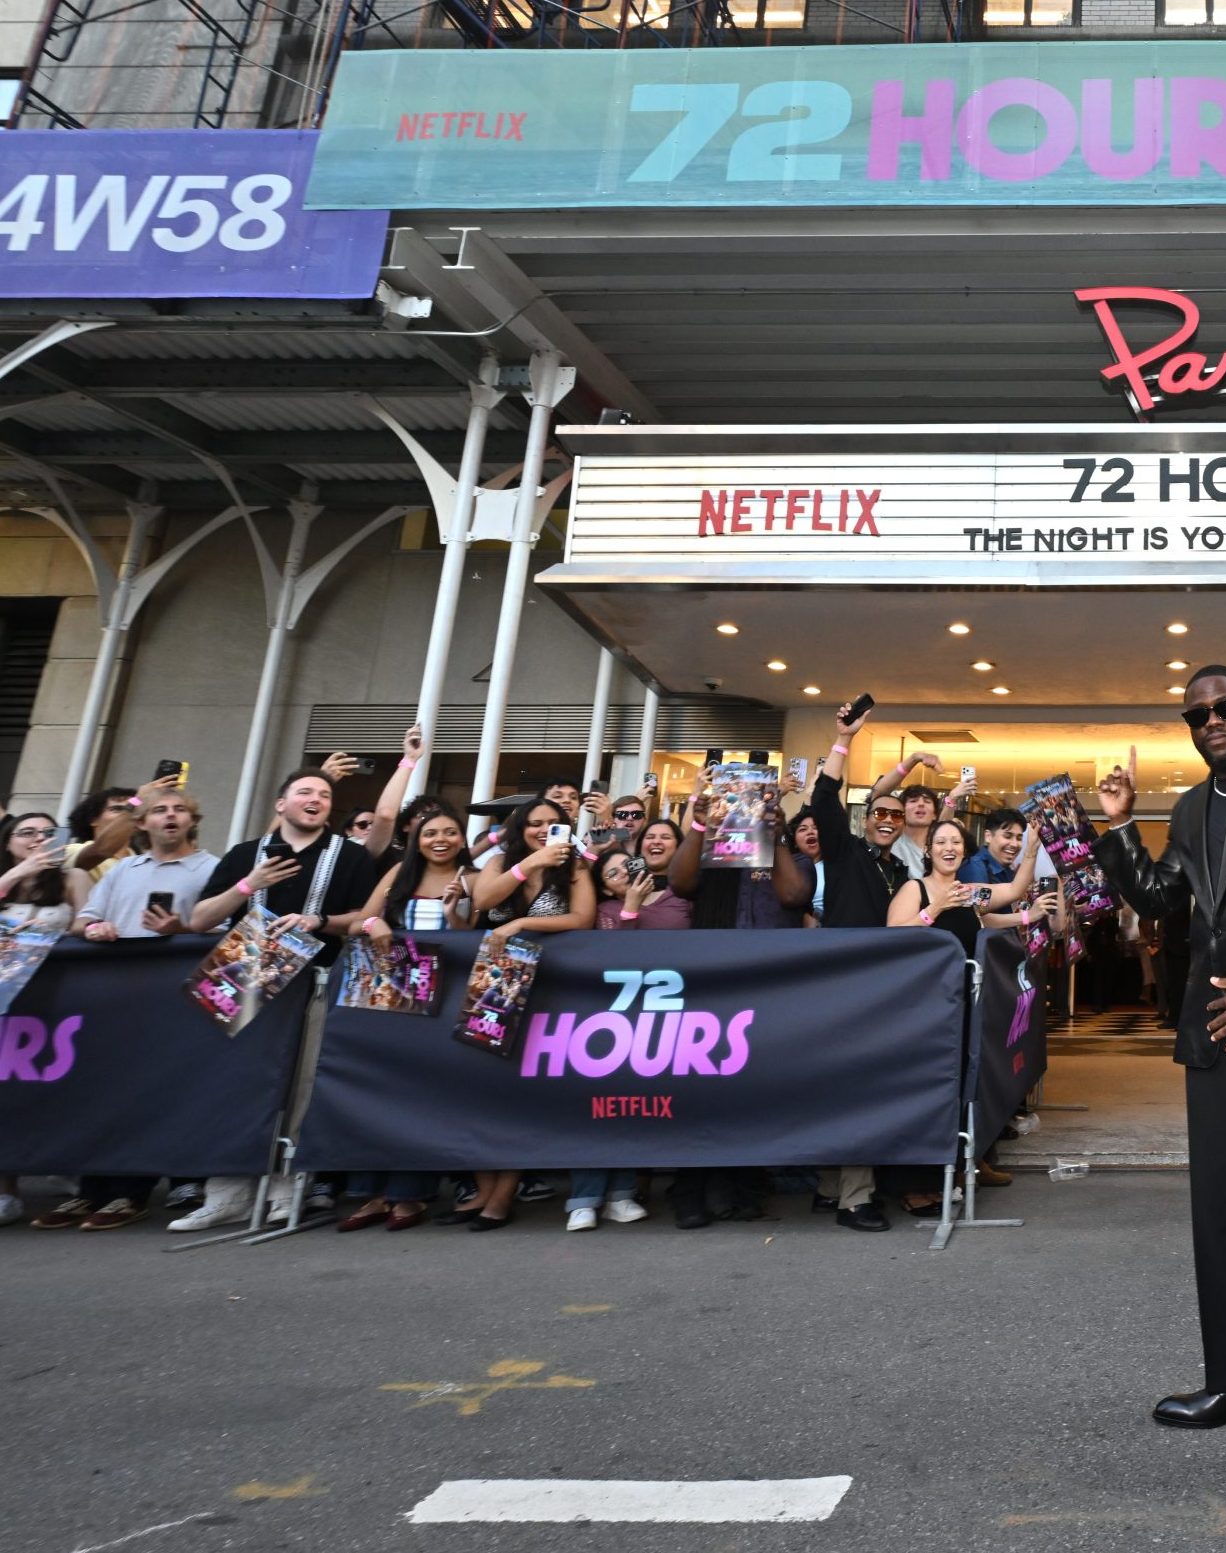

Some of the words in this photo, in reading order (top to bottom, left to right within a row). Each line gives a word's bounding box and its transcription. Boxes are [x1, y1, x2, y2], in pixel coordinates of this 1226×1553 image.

[396, 112, 527, 142] NETFLIX
[625, 81, 852, 182] 72
[0, 174, 293, 252] 4W58
[1063, 457, 1135, 502] 72
[698, 489, 881, 537] NETFLIX
[963, 527, 1022, 550] THE
[1034, 527, 1134, 552] NIGHT
[1143, 527, 1168, 550] IS
[603, 970, 685, 1012] 72
[520, 1009, 755, 1078] HOURS
[591, 1096, 674, 1120] NETFLIX
